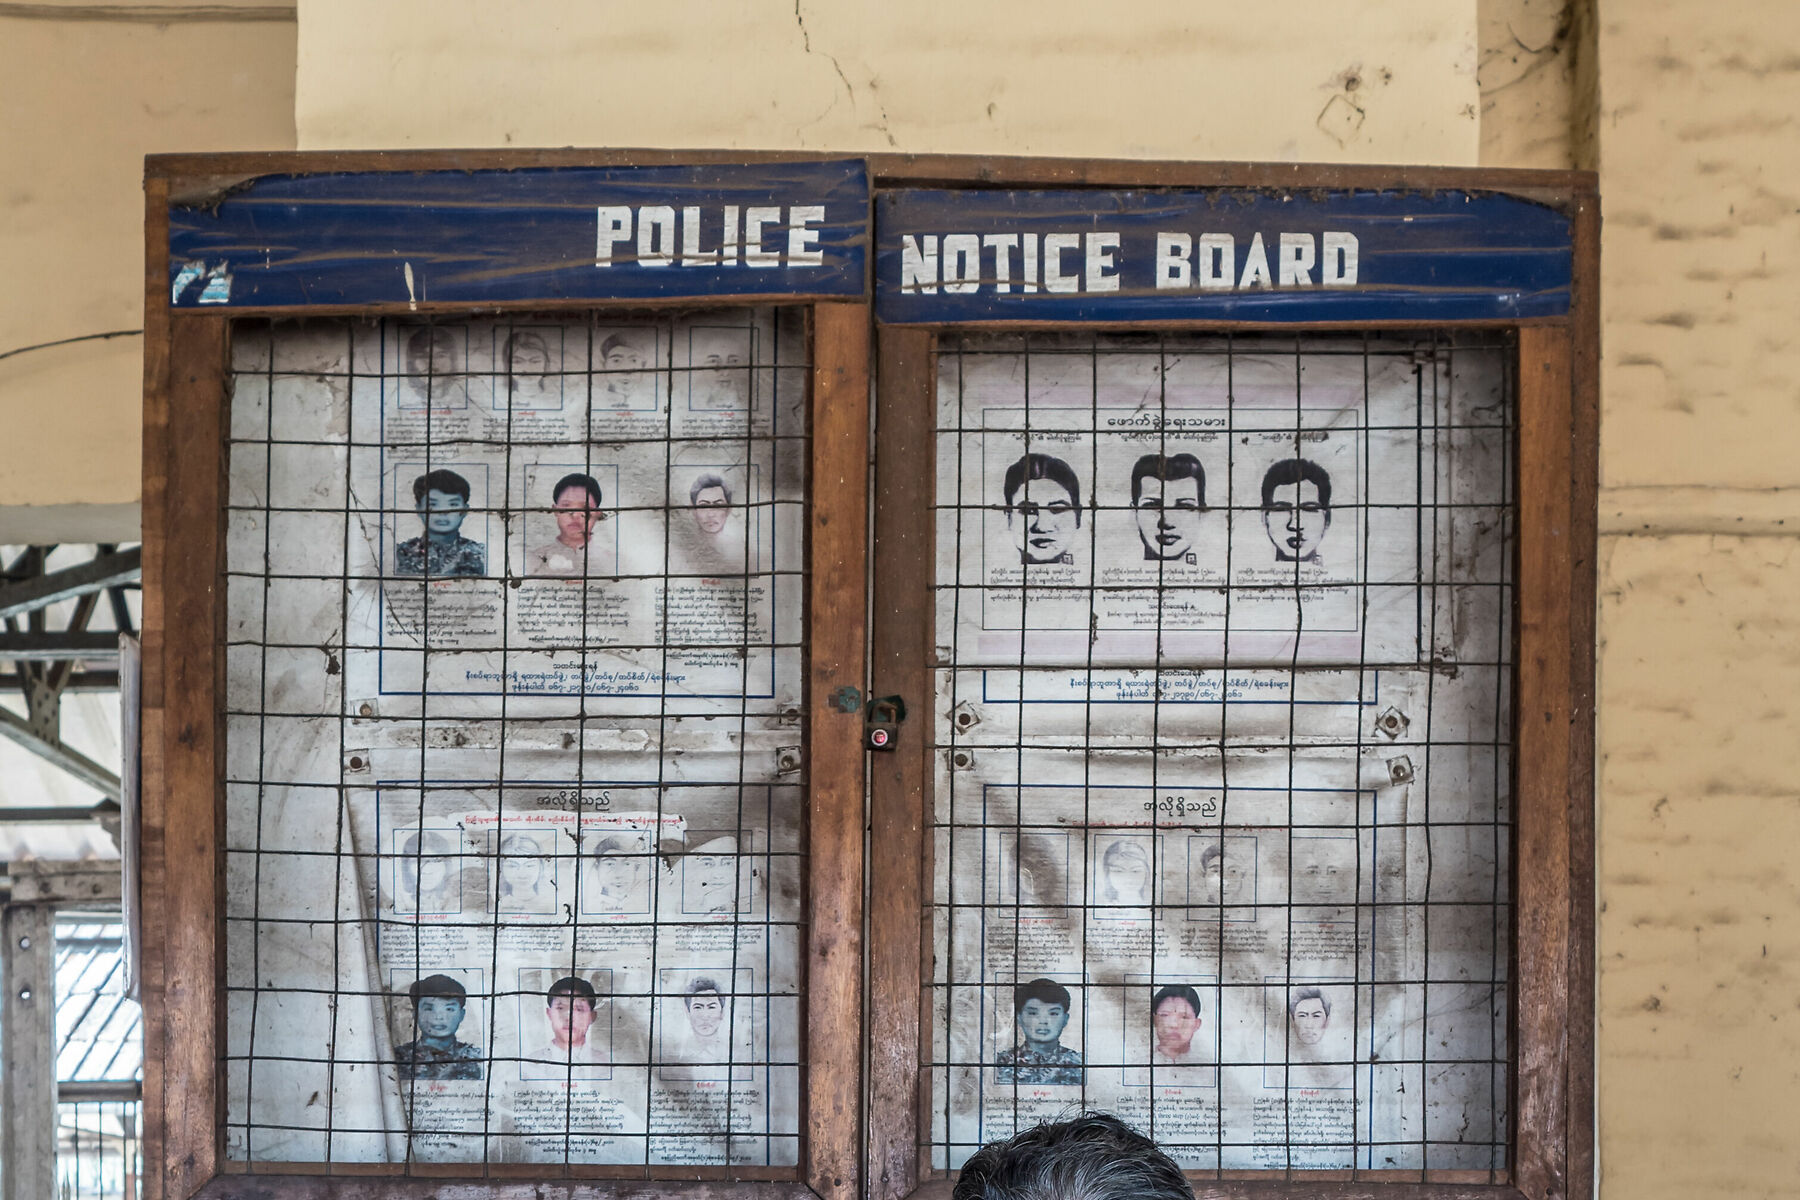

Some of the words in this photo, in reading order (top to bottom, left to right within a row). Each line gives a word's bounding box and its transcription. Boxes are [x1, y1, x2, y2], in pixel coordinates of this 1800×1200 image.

[595, 205, 825, 268] POLICE
[901, 232, 1120, 294] NOTICE
[1156, 231, 1359, 292] BOARD
[553, 660, 598, 672] သတင်းေးရန်
[1143, 796, 1217, 818] အလိုရှိသည်
